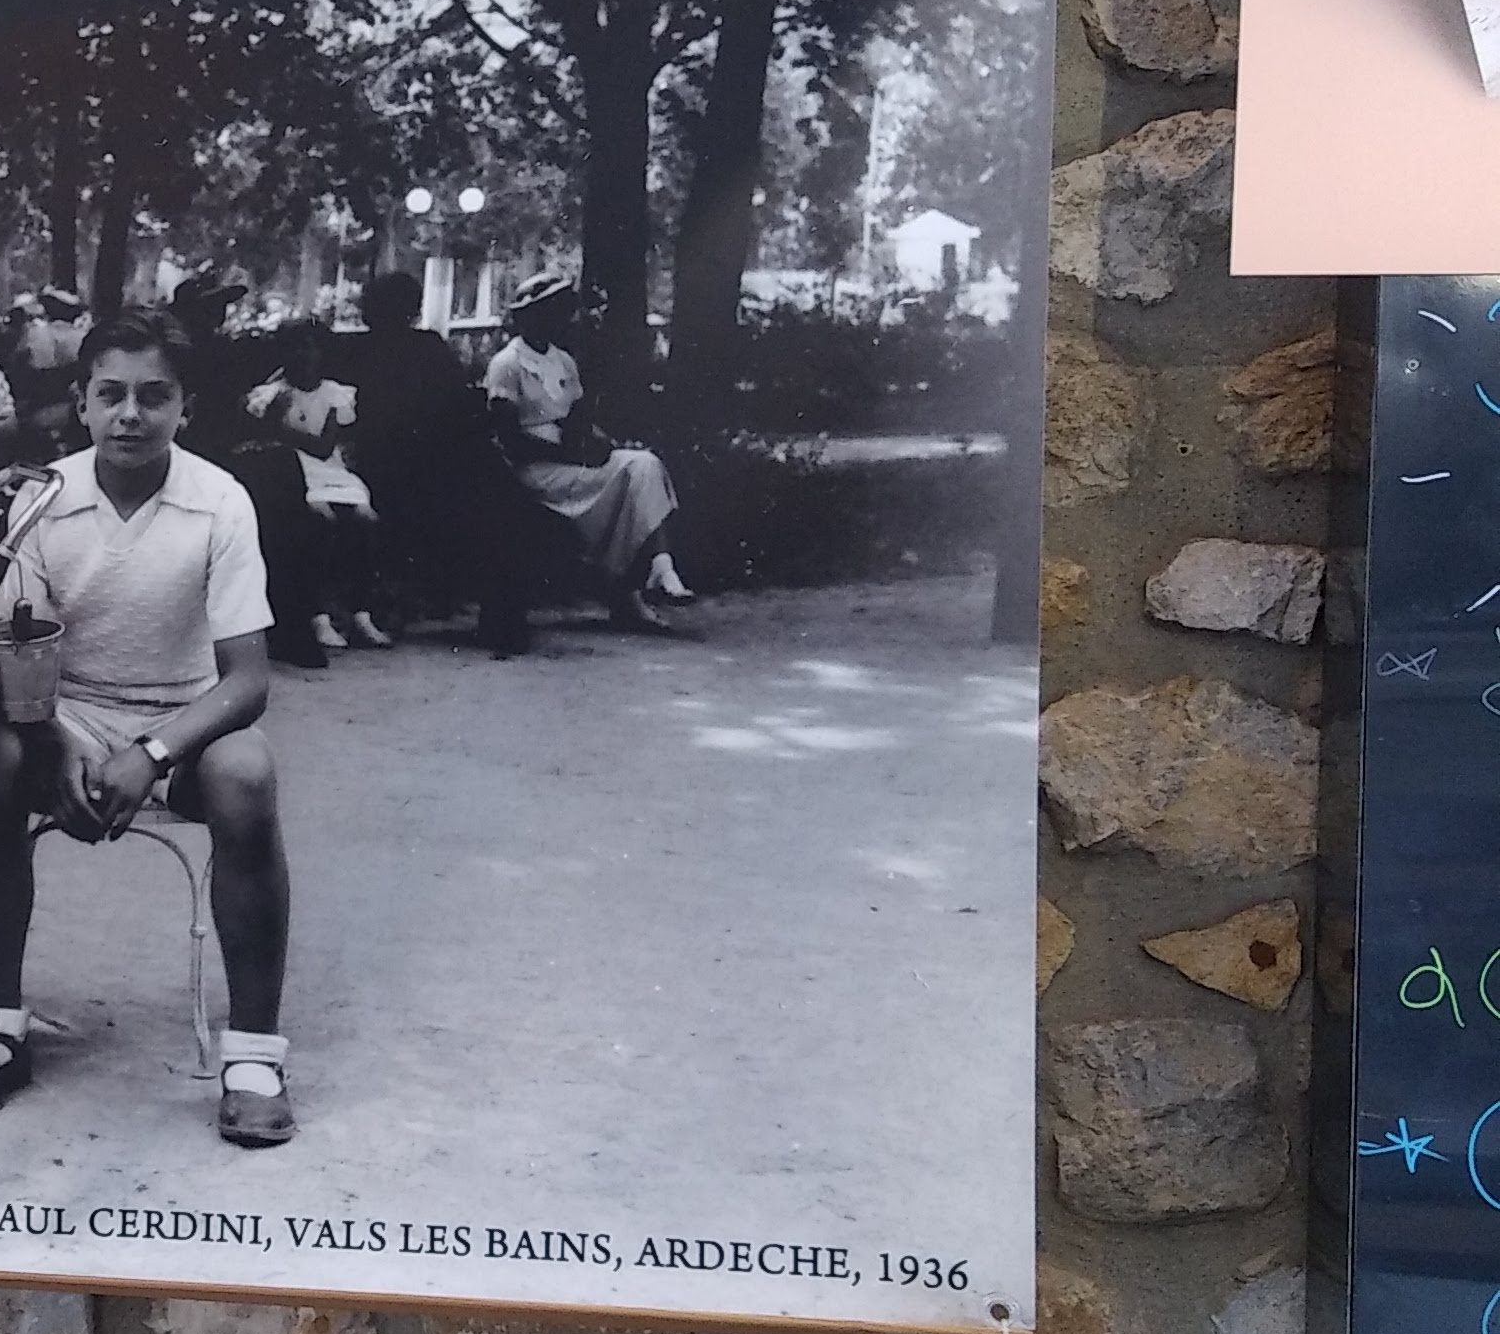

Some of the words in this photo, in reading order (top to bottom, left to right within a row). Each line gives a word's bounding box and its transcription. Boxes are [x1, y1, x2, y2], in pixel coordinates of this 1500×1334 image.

[88, 1208, 272, 1253] CERDINI,
[284, 1217, 386, 1252] VALS
[398, 1223, 471, 1257] LES
[484, 1227, 623, 1273] BAINS,
[634, 1237, 861, 1287] ARDECHE,
[877, 1252, 969, 1291] 1936
